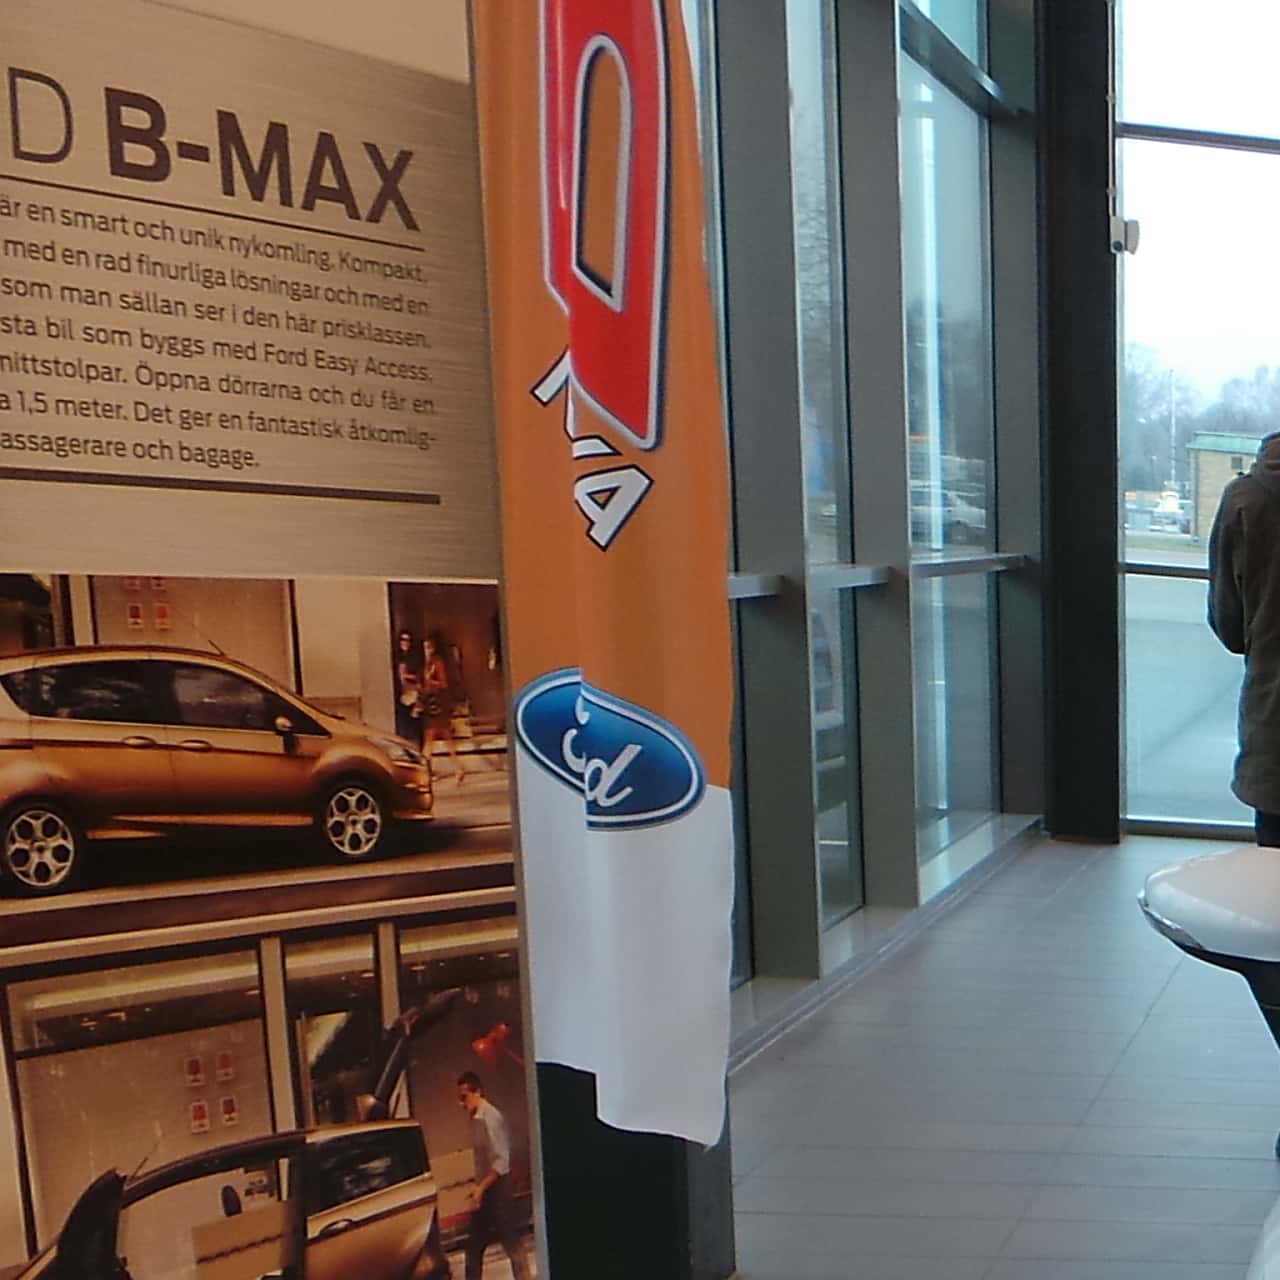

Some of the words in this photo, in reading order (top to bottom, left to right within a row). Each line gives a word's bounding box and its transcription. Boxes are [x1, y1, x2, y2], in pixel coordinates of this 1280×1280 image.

[104, 86, 421, 232] B-MAX
[27, 203, 55, 224] en
[60, 207, 130, 236] smart
[133, 219, 175, 241] och
[179, 226, 225, 250] unik
[229, 234, 335, 272] nykomling.
[3, 239, 56, 262] med
[62, 247, 89, 269] en
[96, 251, 131, 273] rad
[137, 253, 227, 289] finurliga
[231, 267, 320, 301] lösningar
[323, 285, 359, 305] och
[363, 292, 404, 313] med
[408, 299, 429, 315] en
[0, 314, 37, 336] sta
[46, 315, 75, 341] bil
[82, 324, 132, 348] som
[140, 327, 205, 359] byggs
[212, 339, 257, 361] med
[264, 342, 308, 368] Ford
[314, 349, 358, 377] Easy
[1, 276, 52, 300] som
[60, 284, 111, 308] man
[119, 290, 187, 317] sällan
[195, 302, 225, 322] ser
[232, 303, 237, 324] i
[242, 305, 279, 329] den
[286, 310, 315, 334] här
[323, 318, 432, 350] prisklassen.
[17, 391, 48, 416] 1,5
[55, 399, 129, 421] meter.
[134, 401, 172, 426] Det
[179, 408, 213, 431] ger
[219, 412, 242, 430] en
[247, 410, 345, 440] fantastisk
[135, 360, 211, 392] Öppna
[218, 373, 301, 401] dörrarna
[308, 384, 344, 405] och
[350, 388, 374, 408] du
[380, 389, 406, 411] får
[412, 398, 434, 414] en
[0, 432, 127, 459] assagerare
[132, 439, 174, 461] och
[178, 441, 260, 470] bagage.
